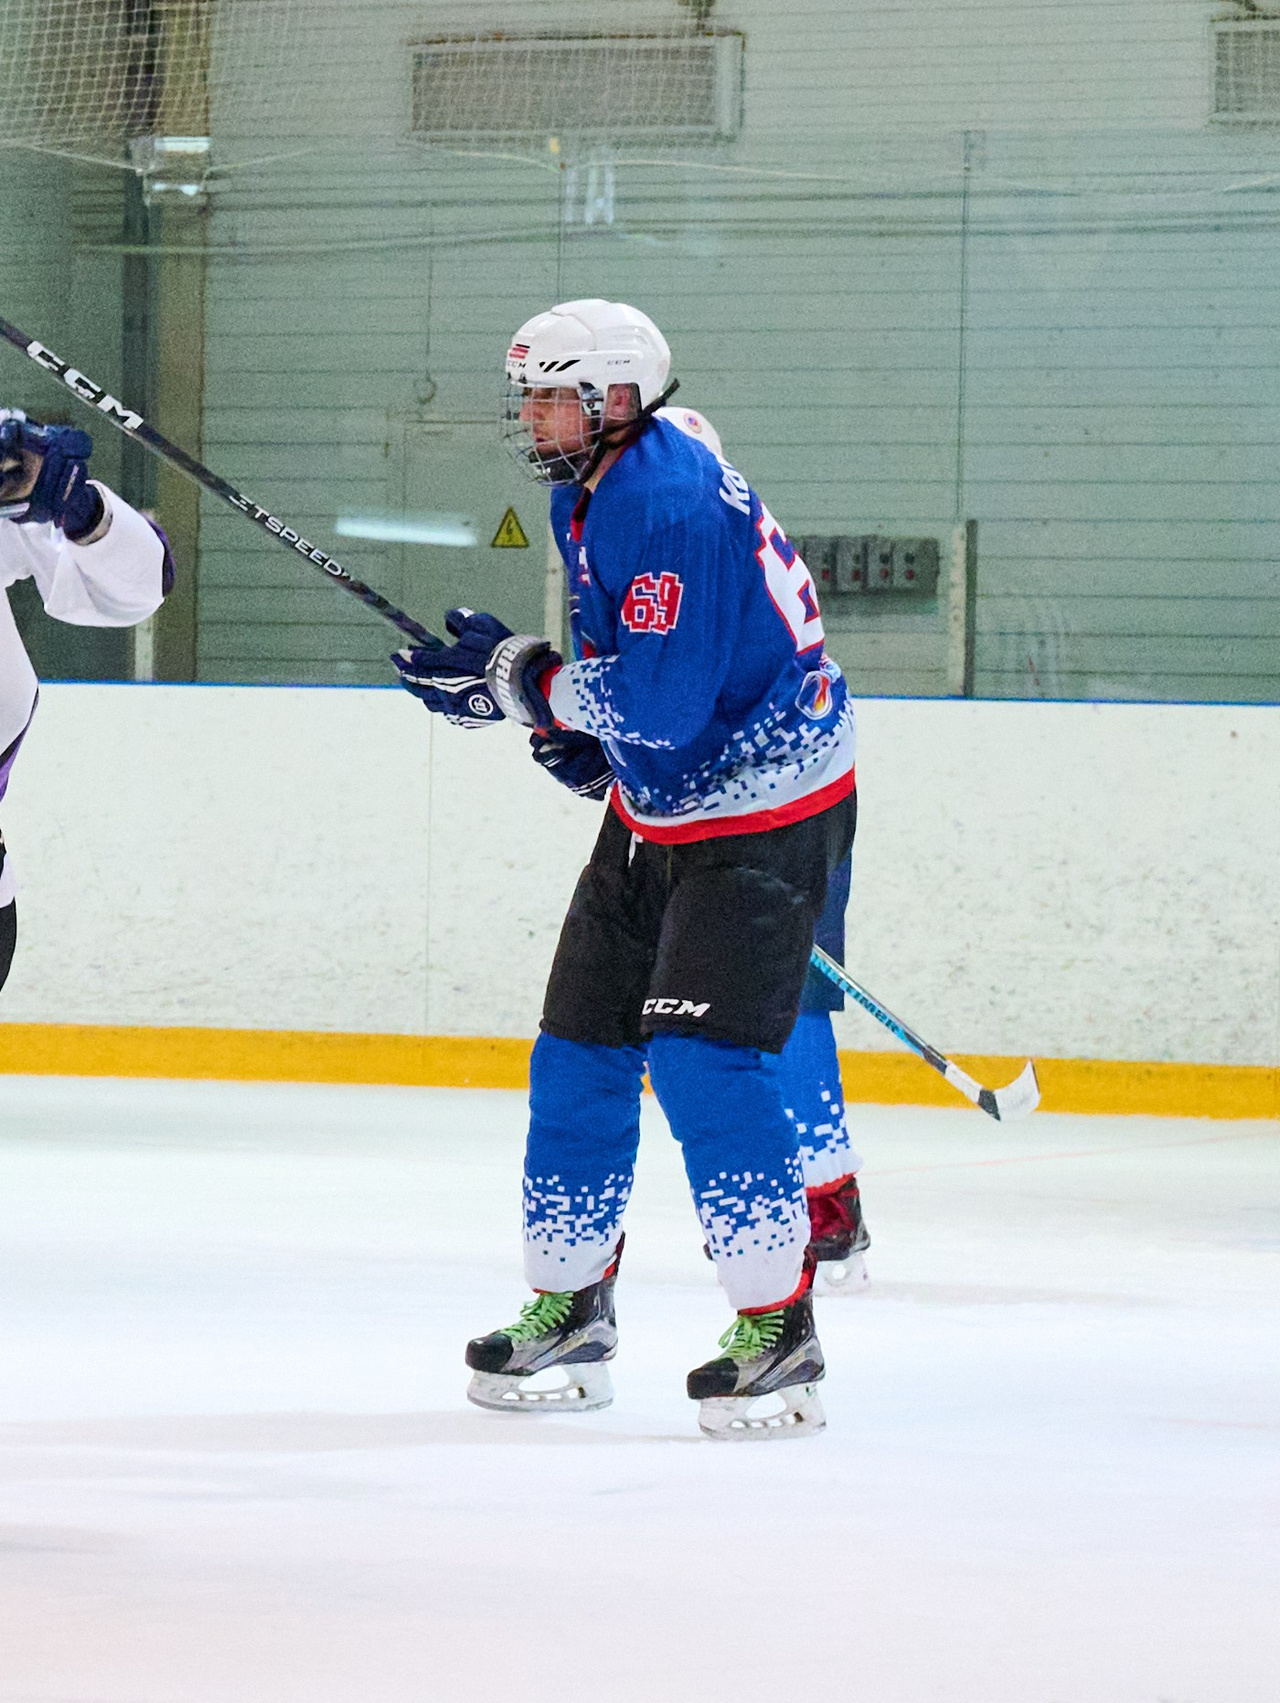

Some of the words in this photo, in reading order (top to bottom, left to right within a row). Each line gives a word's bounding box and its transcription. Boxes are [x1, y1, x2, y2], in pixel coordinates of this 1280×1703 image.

[27, 341, 144, 430] CCM
[621, 571, 683, 635] 69
[642, 998, 711, 1017] CCM
